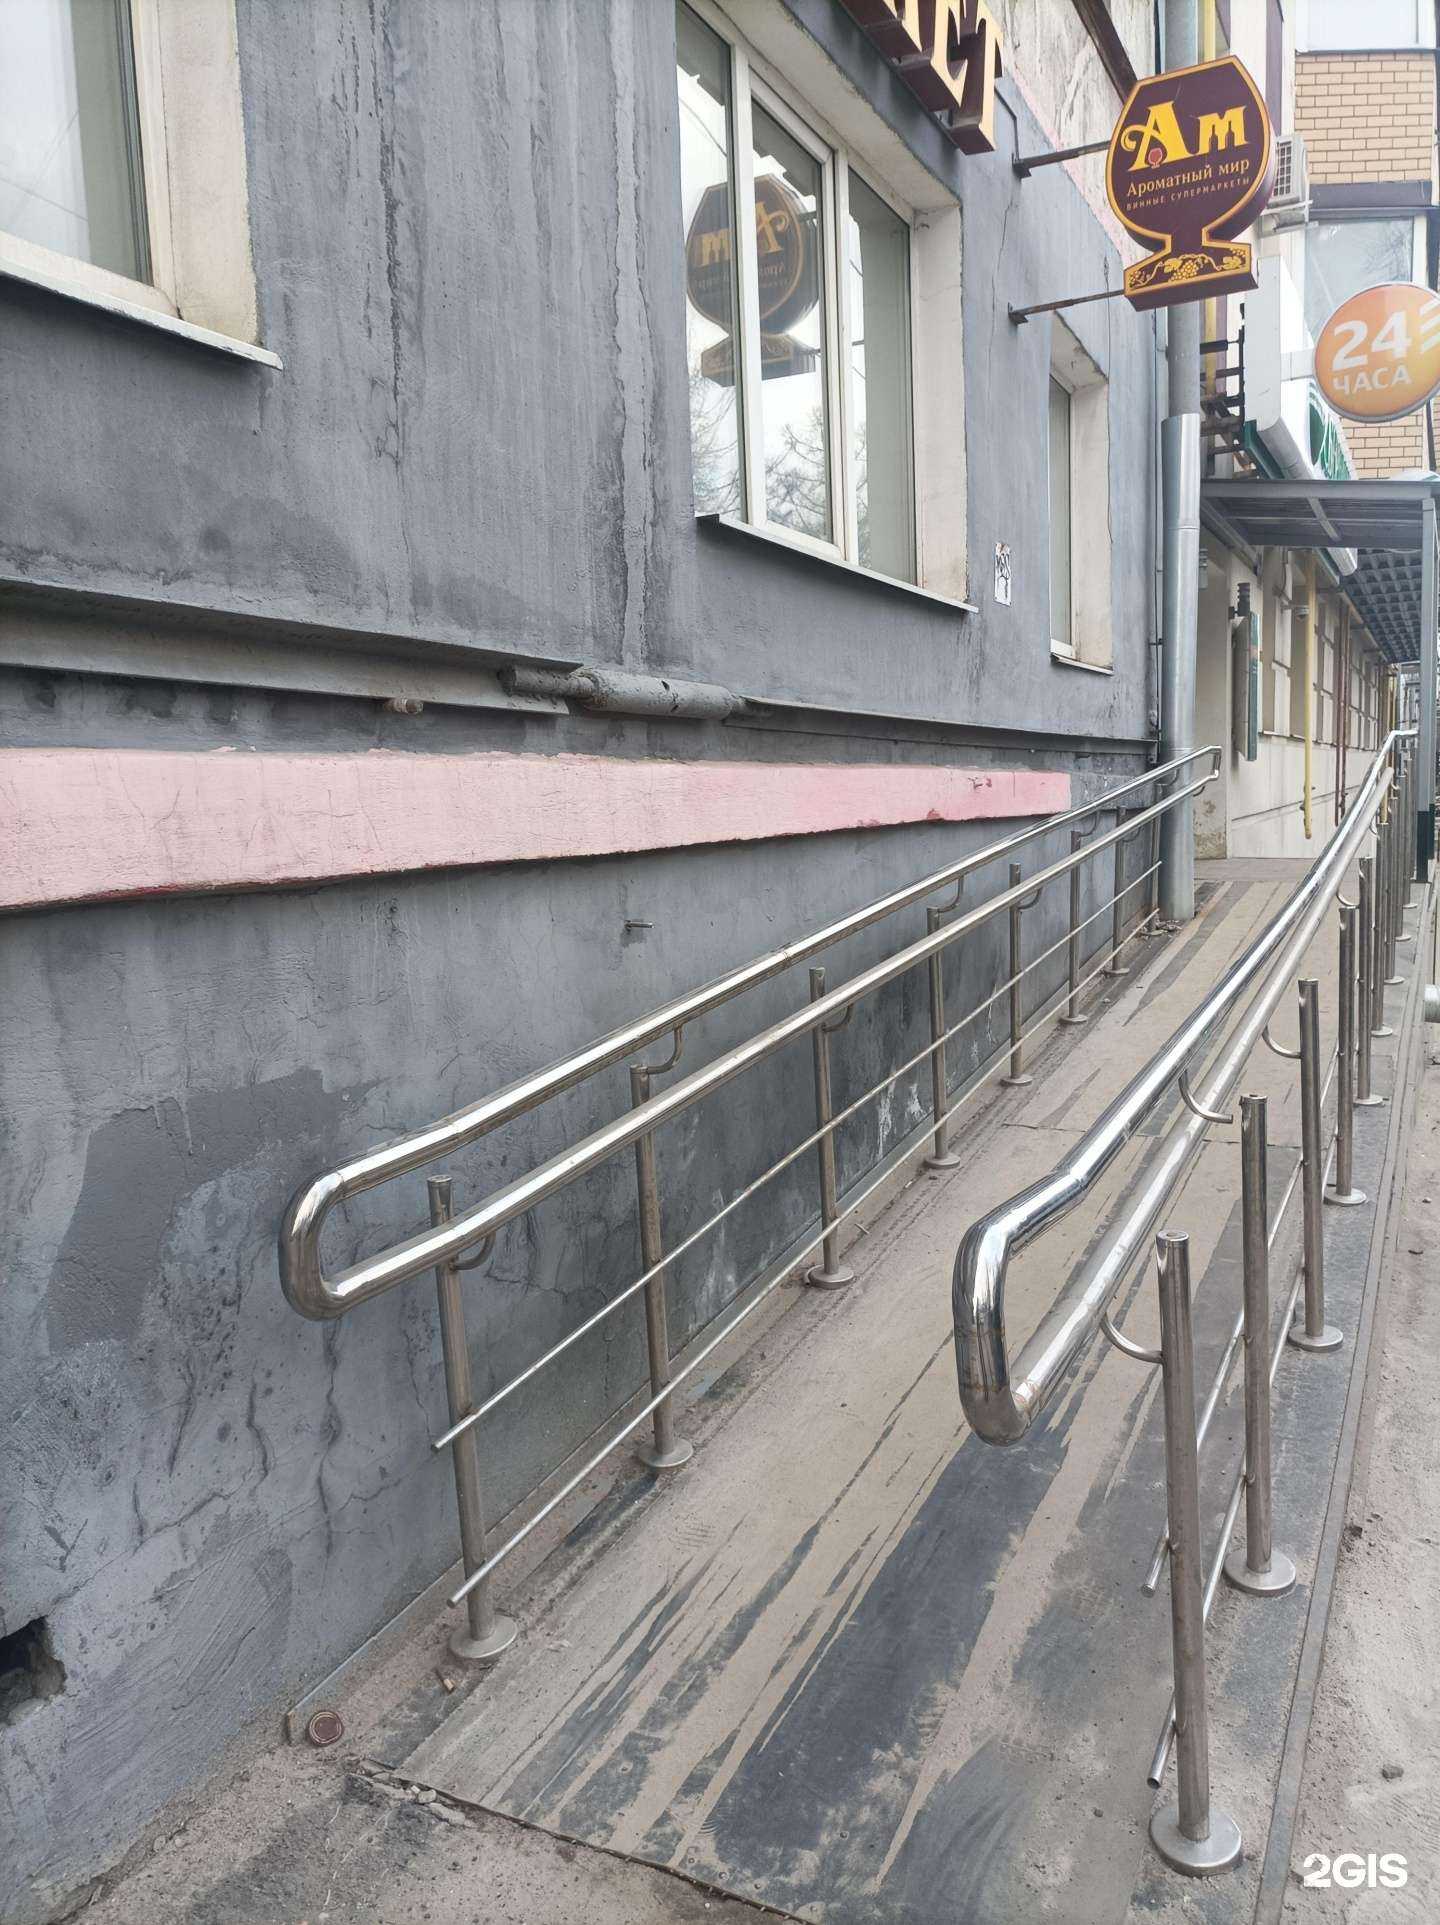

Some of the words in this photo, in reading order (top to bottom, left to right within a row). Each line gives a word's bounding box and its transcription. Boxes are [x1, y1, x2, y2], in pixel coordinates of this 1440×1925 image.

[1127, 164, 1213, 198] Ароматный
[1218, 159, 1250, 176] мир
[1170, 177, 1250, 201] СУПЕРМАРКЕТЫ
[1332, 311, 1412, 372] 24
[1332, 364, 1412, 395] ЧАСА
